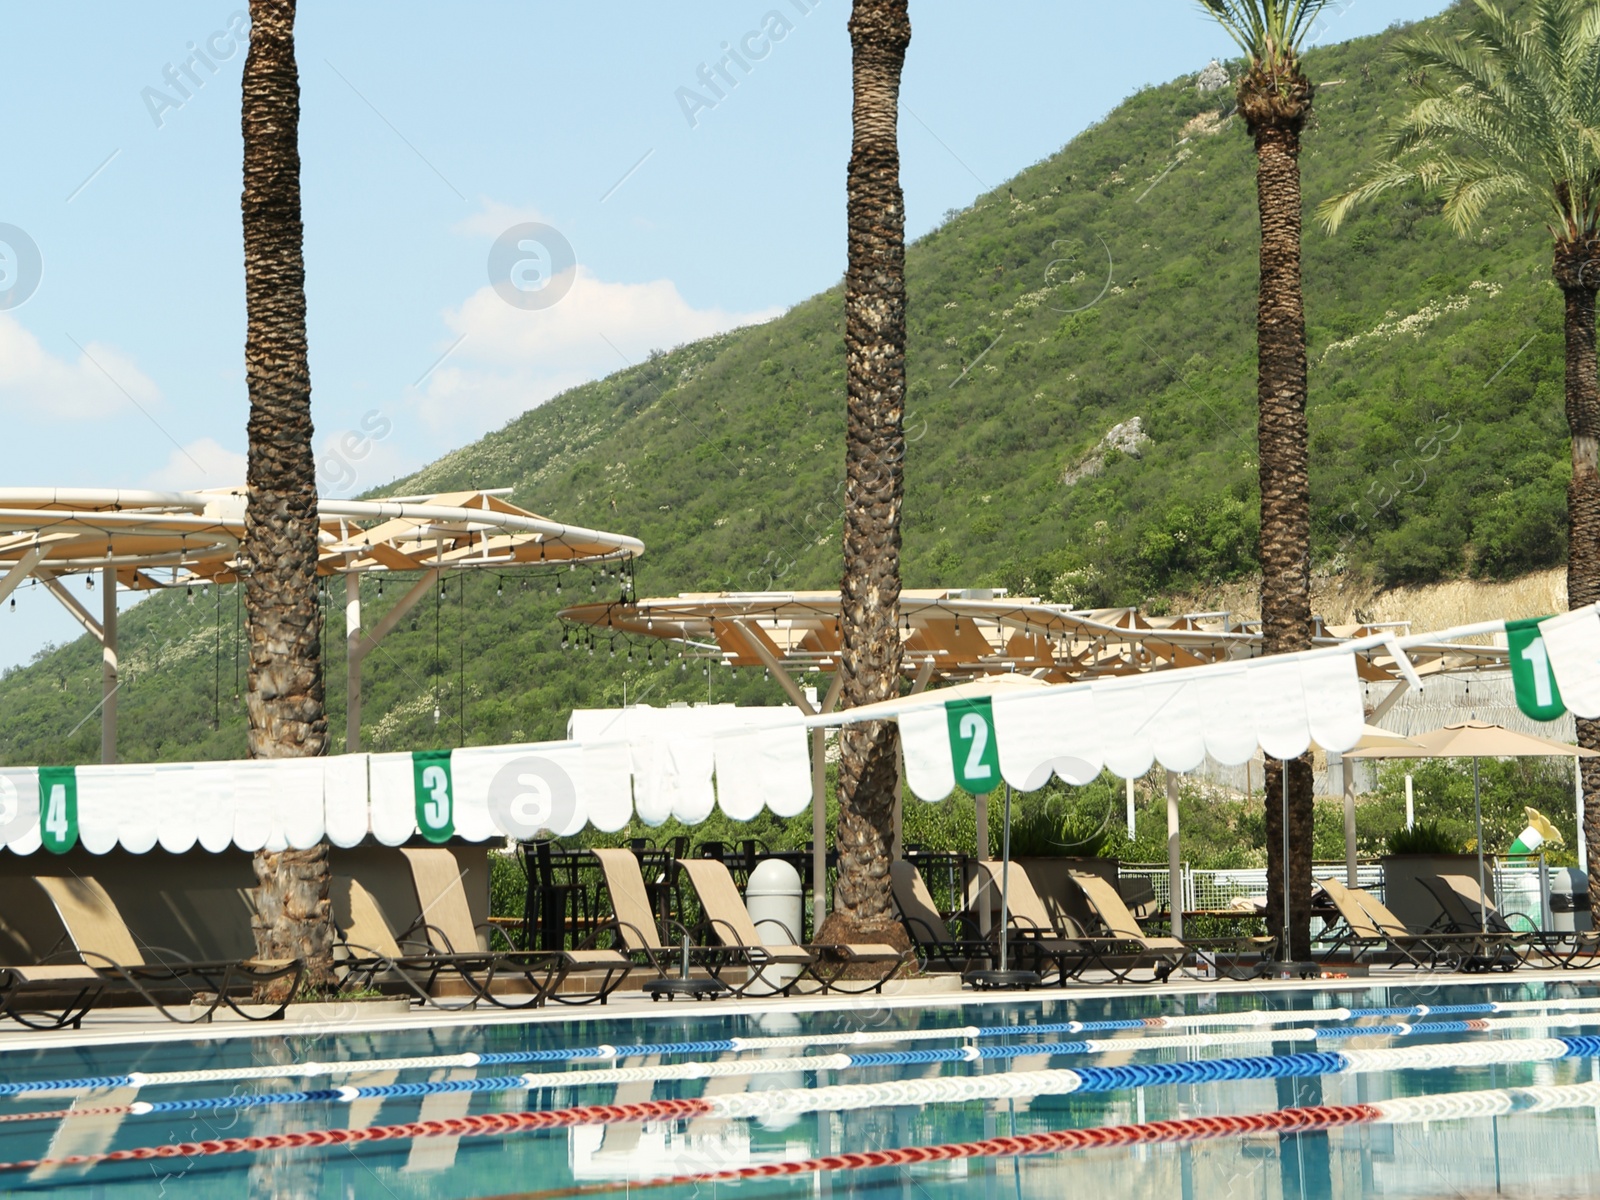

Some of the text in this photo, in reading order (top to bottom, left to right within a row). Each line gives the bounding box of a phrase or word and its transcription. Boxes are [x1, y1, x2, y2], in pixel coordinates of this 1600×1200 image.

[1521, 637, 1552, 706] 1
[959, 712, 991, 780] 2
[46, 784, 69, 842] 4
[422, 765, 450, 829] 3
